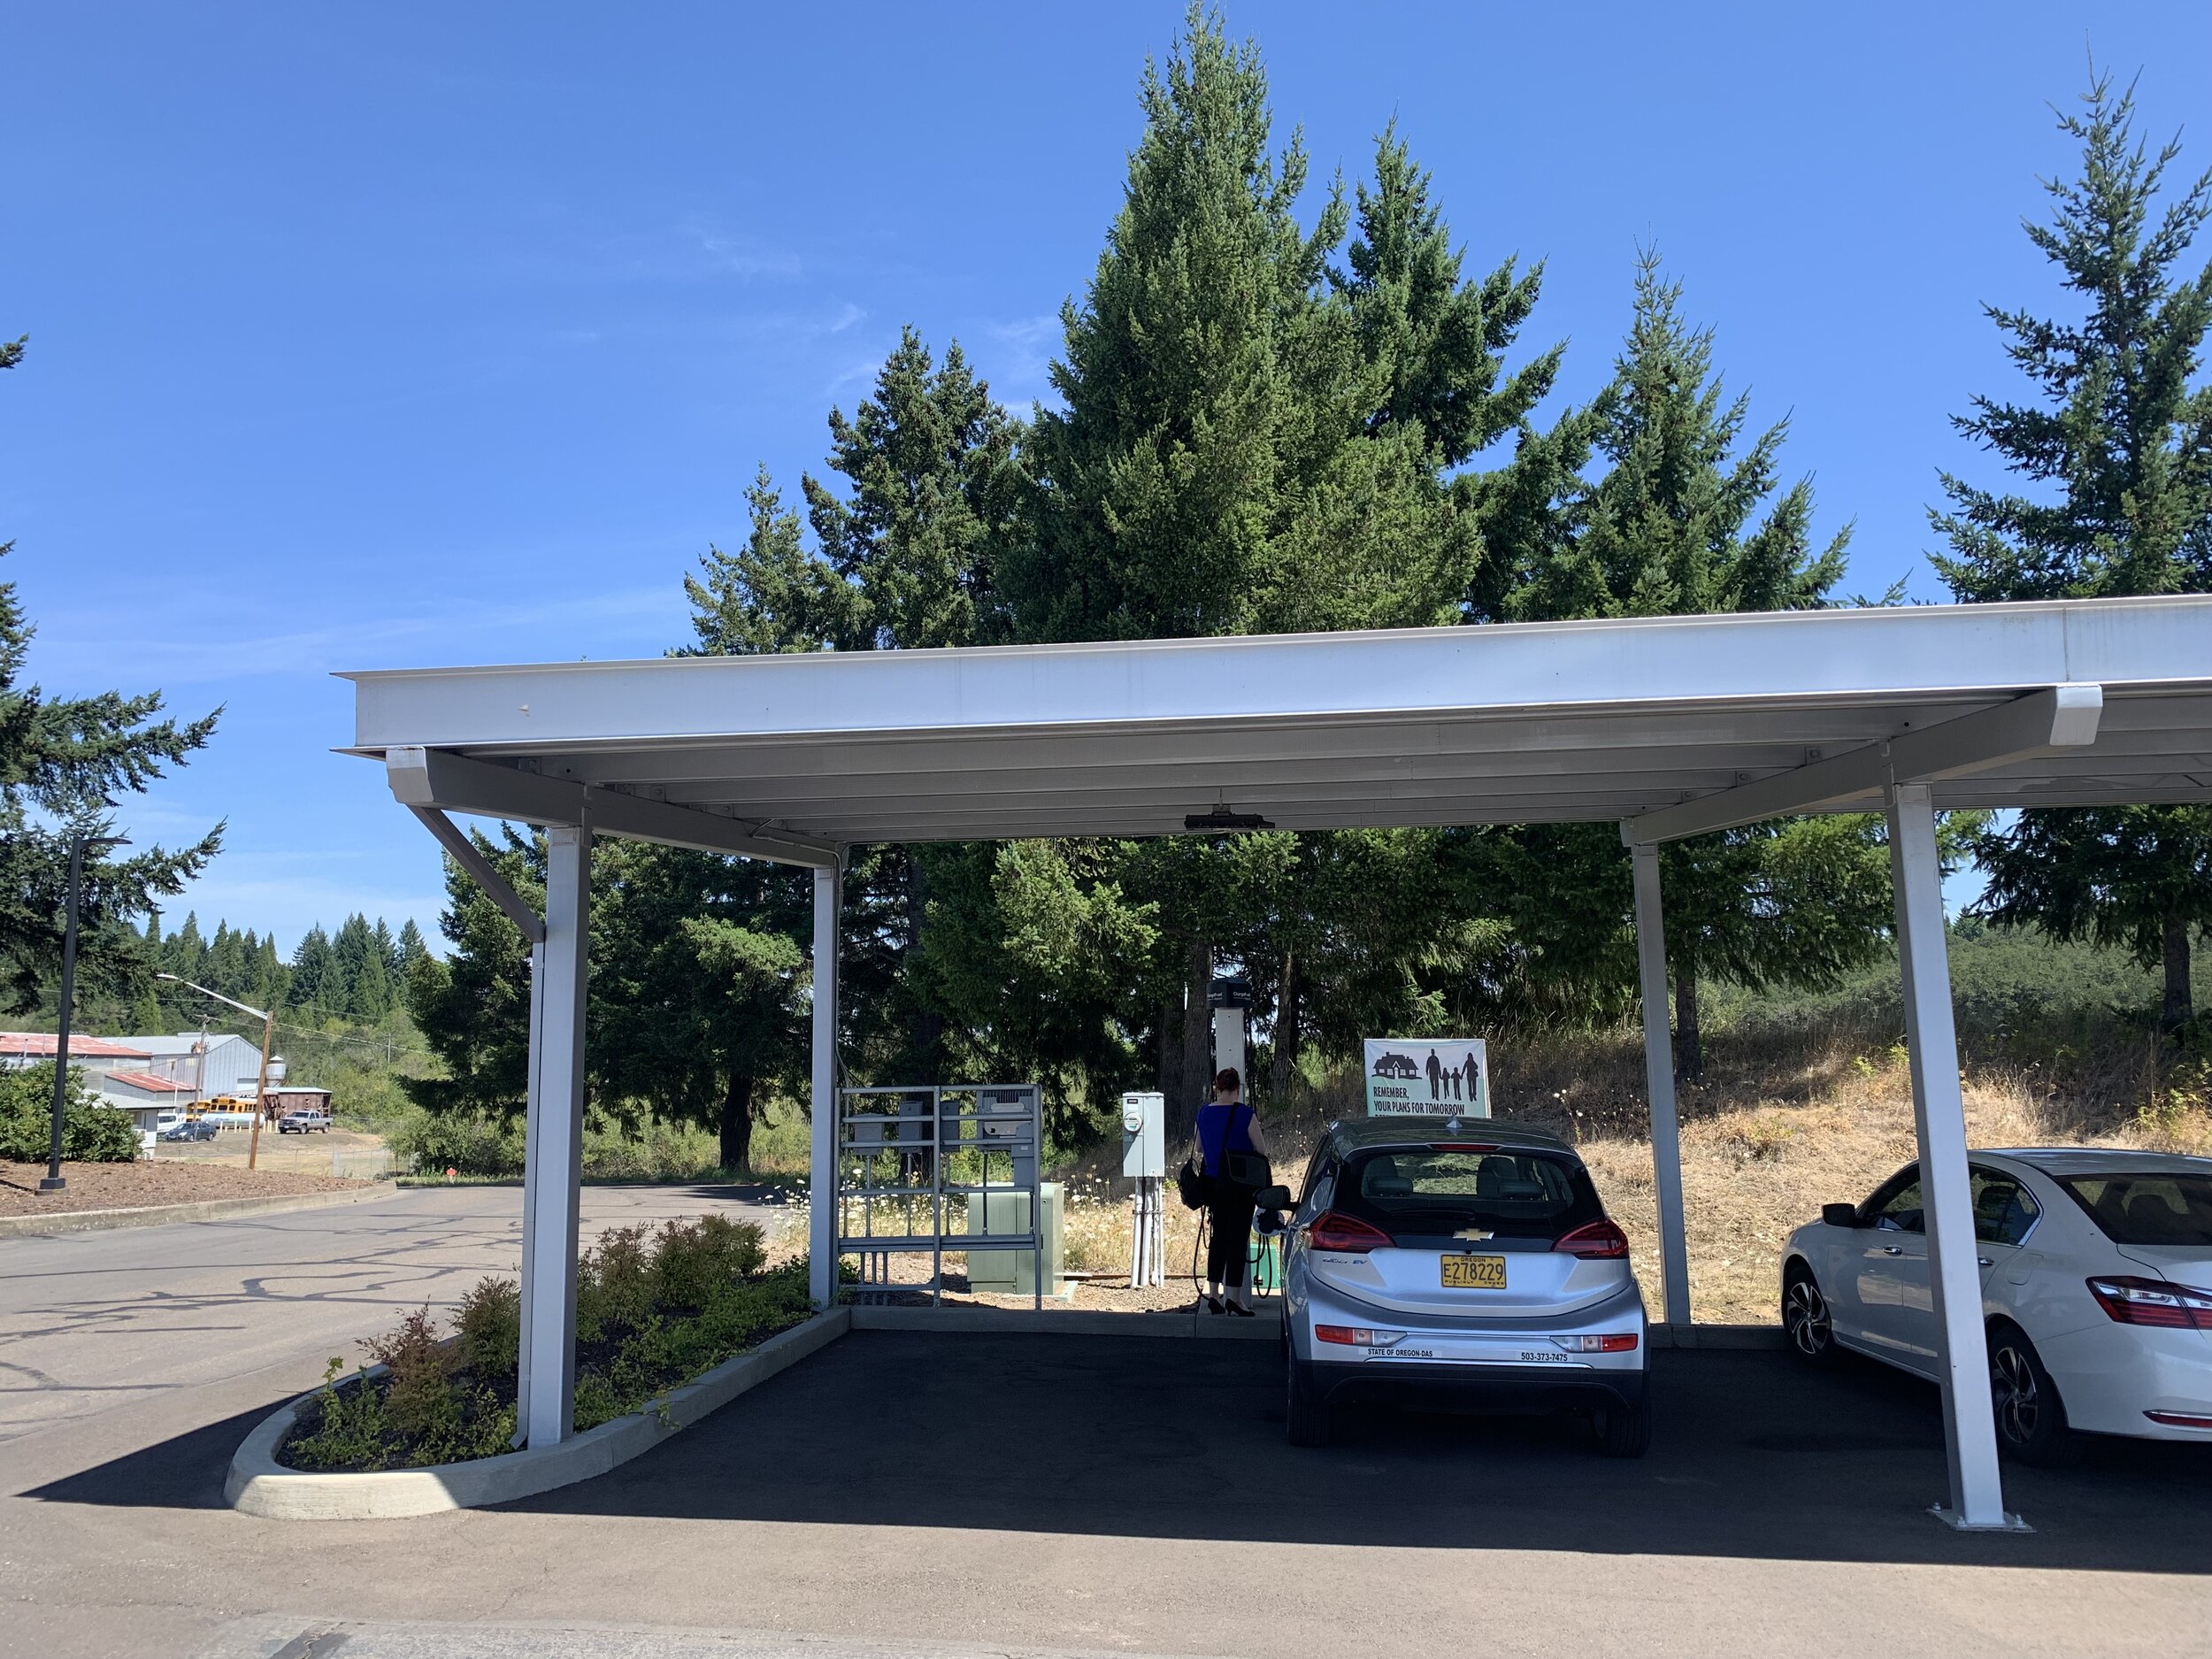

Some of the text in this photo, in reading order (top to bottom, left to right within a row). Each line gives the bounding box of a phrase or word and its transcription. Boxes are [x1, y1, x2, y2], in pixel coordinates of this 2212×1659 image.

[1373, 1087, 1409, 1100] REMEMBER,
[1373, 1100, 1464, 1115] YOUR PLANS FOR TOMORROW
[1443, 1262, 1503, 1281] E278229
[1521, 1352, 1568, 1362] 503-373-7475
